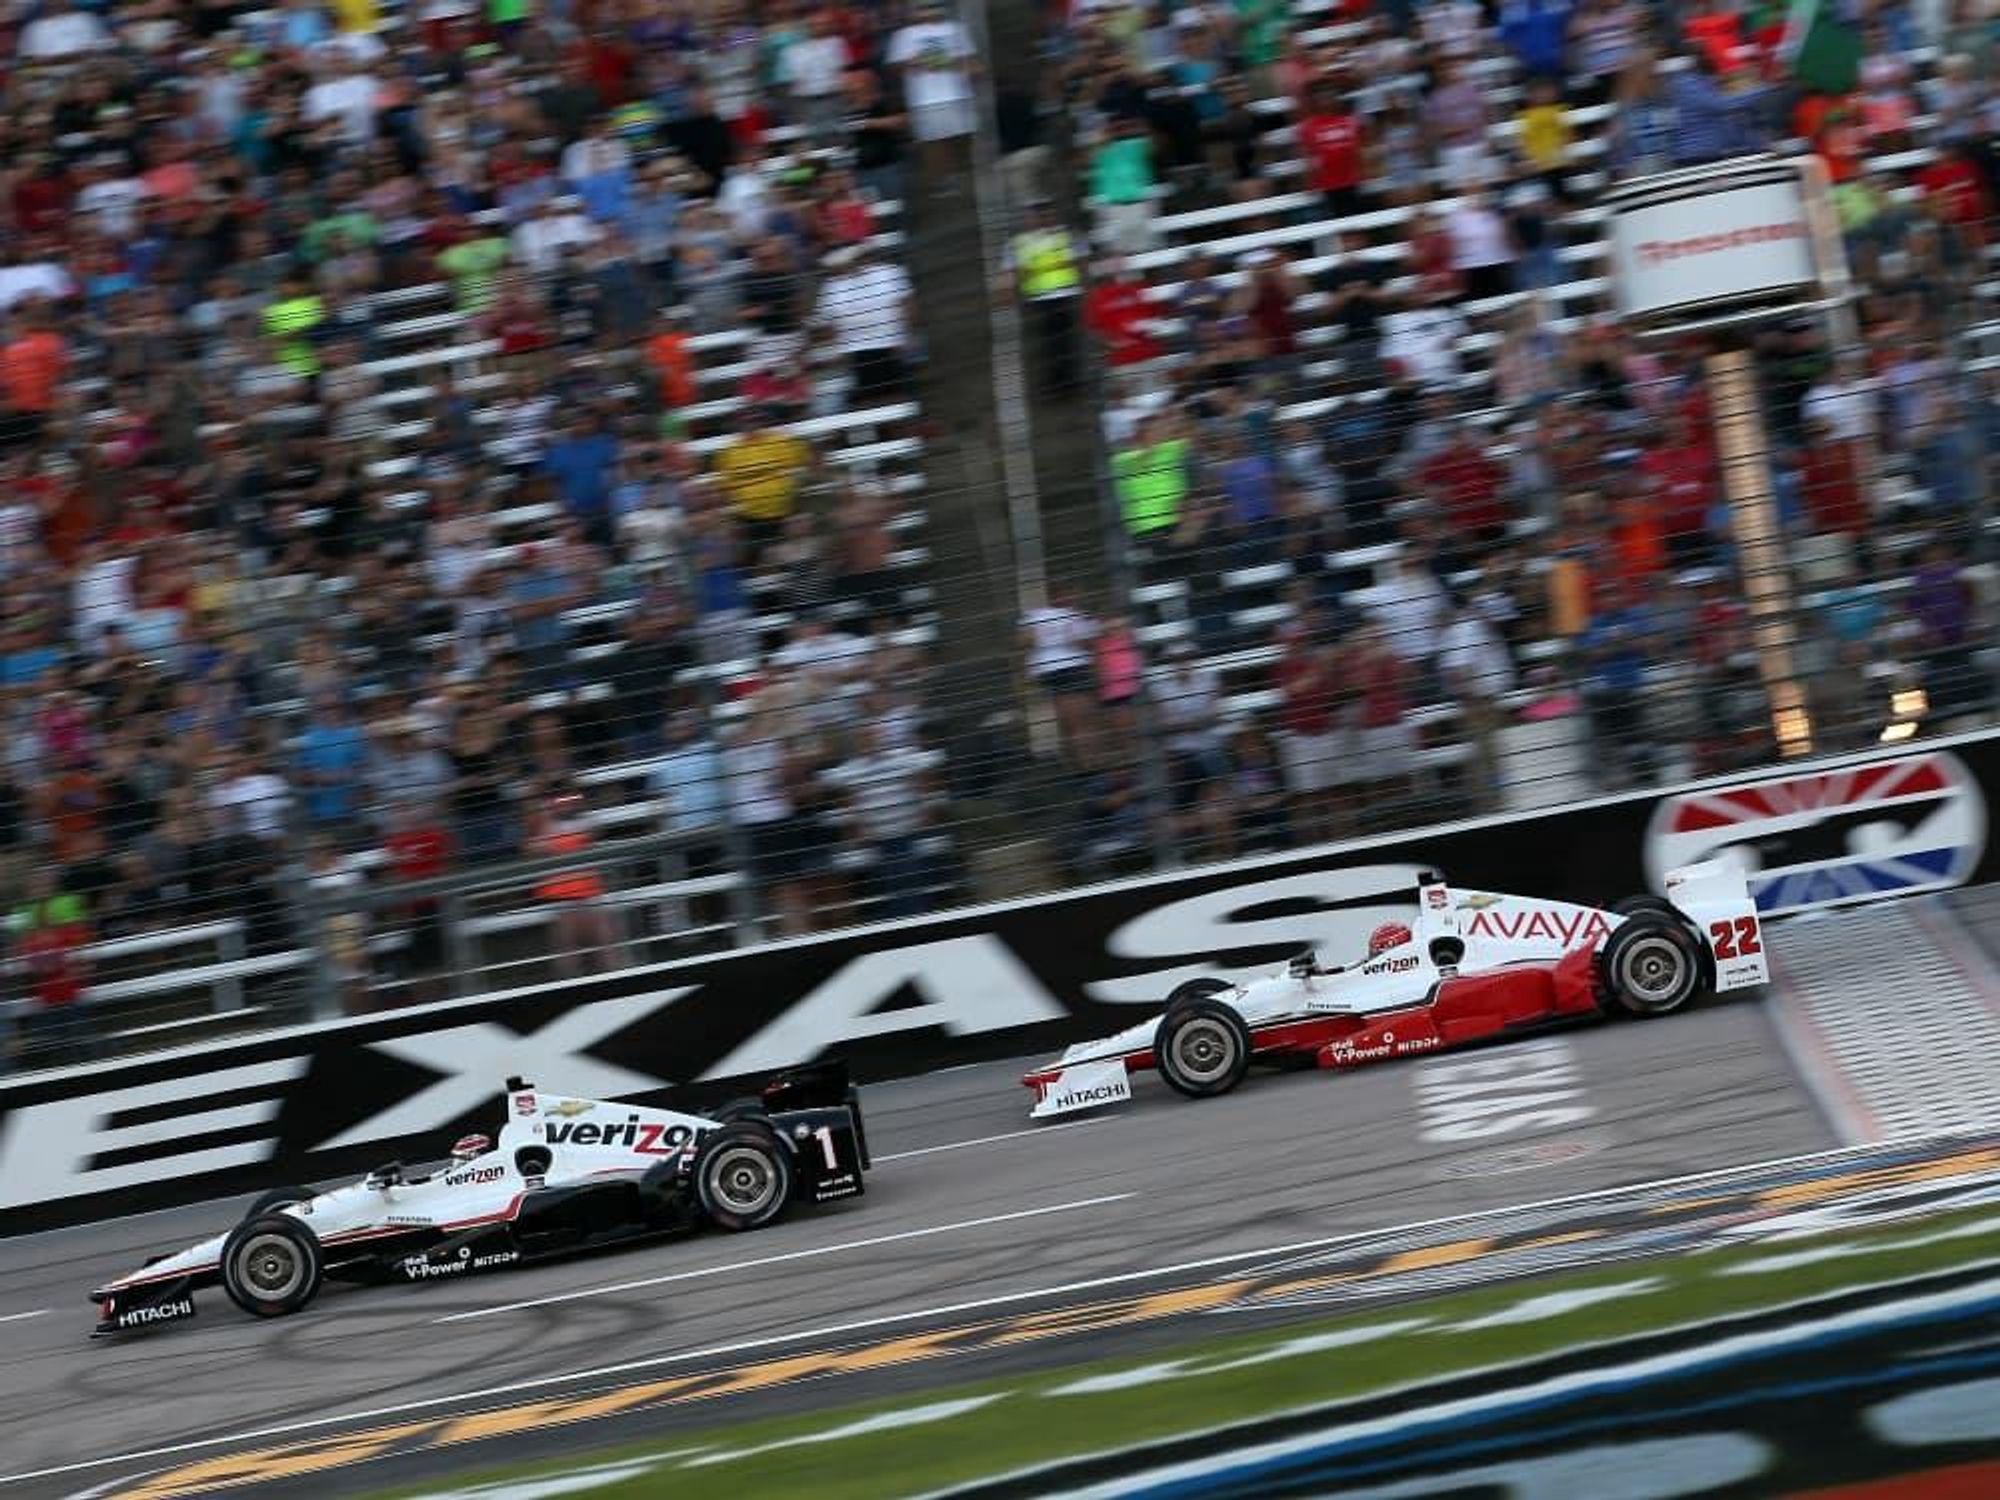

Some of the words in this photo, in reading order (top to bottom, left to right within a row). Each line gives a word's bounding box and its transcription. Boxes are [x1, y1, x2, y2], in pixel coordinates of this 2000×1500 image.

[1468, 911, 1612, 947] AVAYA
[1710, 916, 1761, 960] 22
[1362, 956, 1420, 976] verizon
[1333, 1044, 1391, 1063] V-Power
[1057, 1083, 1126, 1107] HITACHI
[812, 1126, 837, 1170] 1
[446, 1166, 504, 1185] verizon
[405, 1260, 467, 1279] V-Power
[120, 1300, 192, 1327] HITACHI
